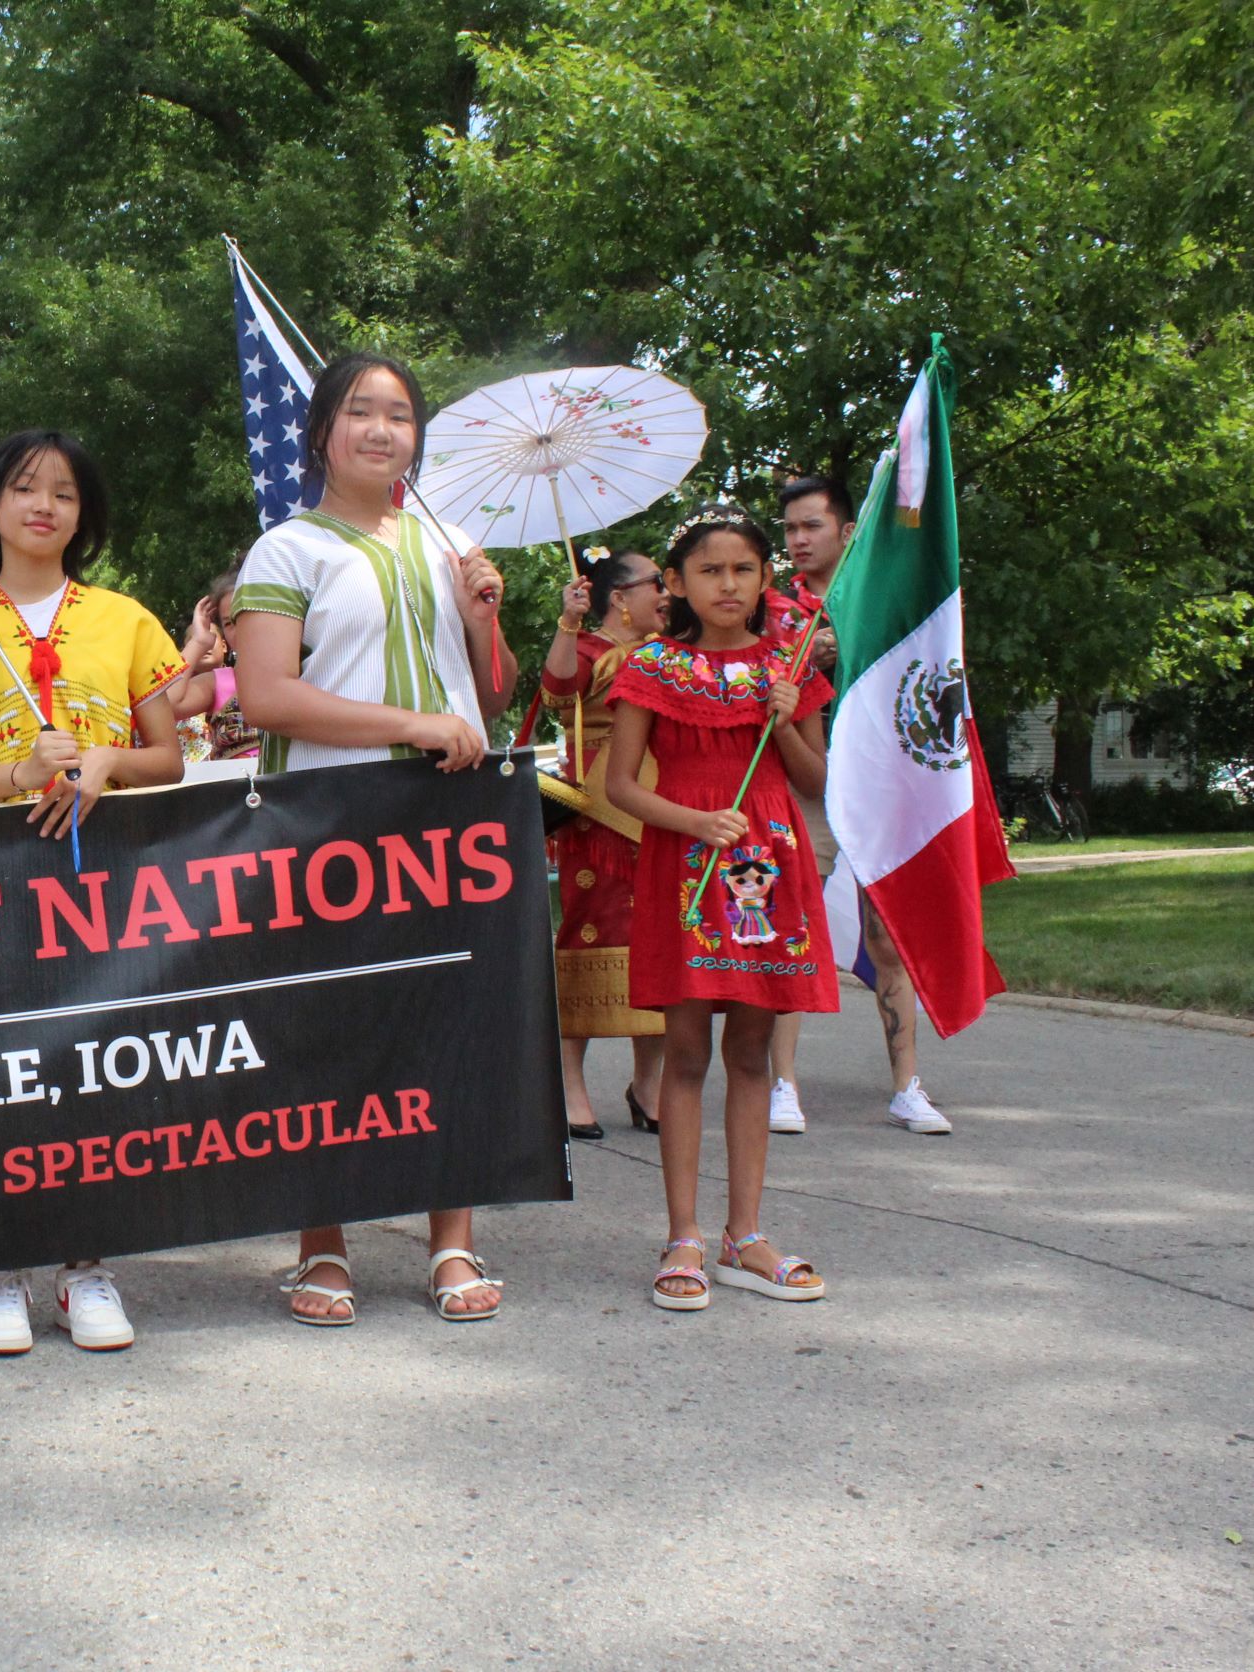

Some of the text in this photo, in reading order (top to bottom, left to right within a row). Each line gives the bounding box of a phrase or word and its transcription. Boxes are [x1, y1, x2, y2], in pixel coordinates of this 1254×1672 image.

[28, 821, 514, 960] NATIONS
[74, 1019, 266, 1094] IOWA
[2, 1088, 438, 1194] SPECTACULAR
